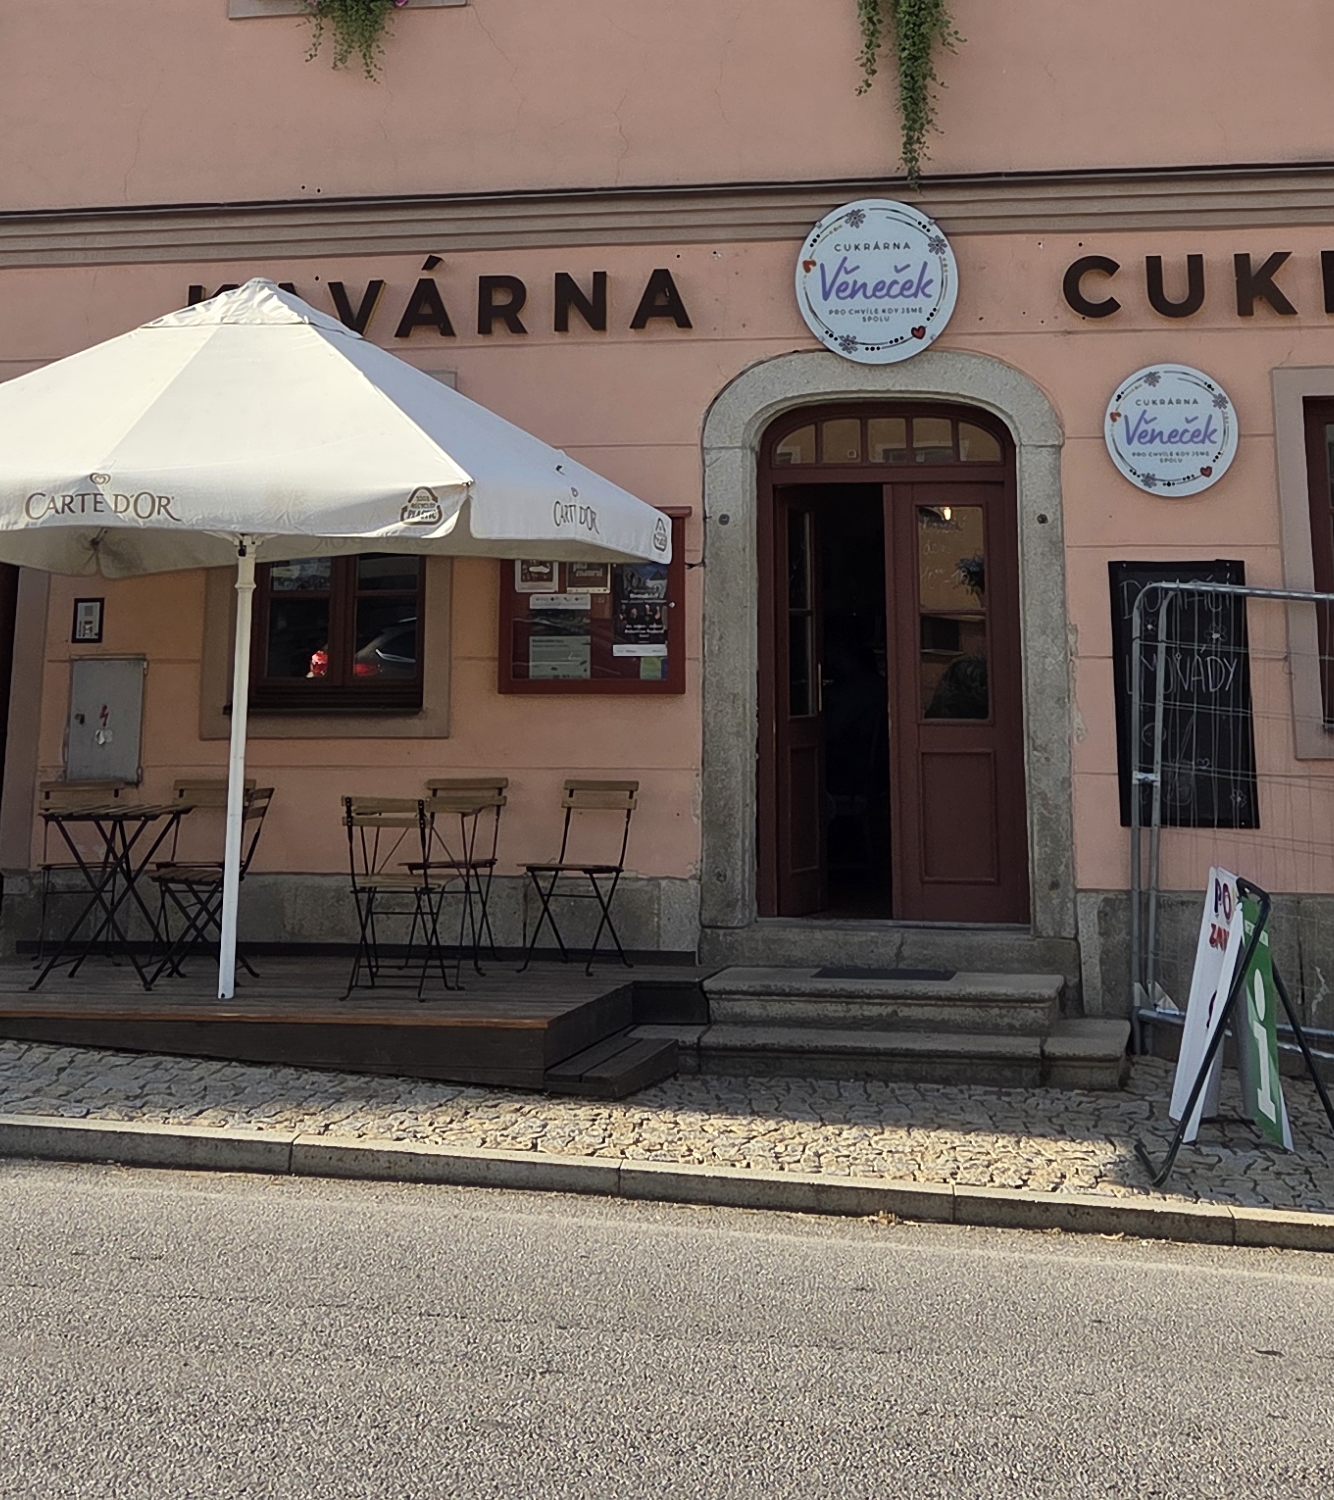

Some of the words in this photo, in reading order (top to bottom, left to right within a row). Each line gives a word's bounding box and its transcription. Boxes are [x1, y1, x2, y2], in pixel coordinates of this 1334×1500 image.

[833, 240, 911, 253] CUKRÁRNA
[188, 254, 694, 338] VÁRNA
[819, 255, 934, 302] Věneček
[1135, 397, 1200, 407] CUKRÁRNA
[1123, 409, 1218, 446] Věneček
[24, 491, 106, 521] CARTE
[112, 490, 182, 523] D'OR
